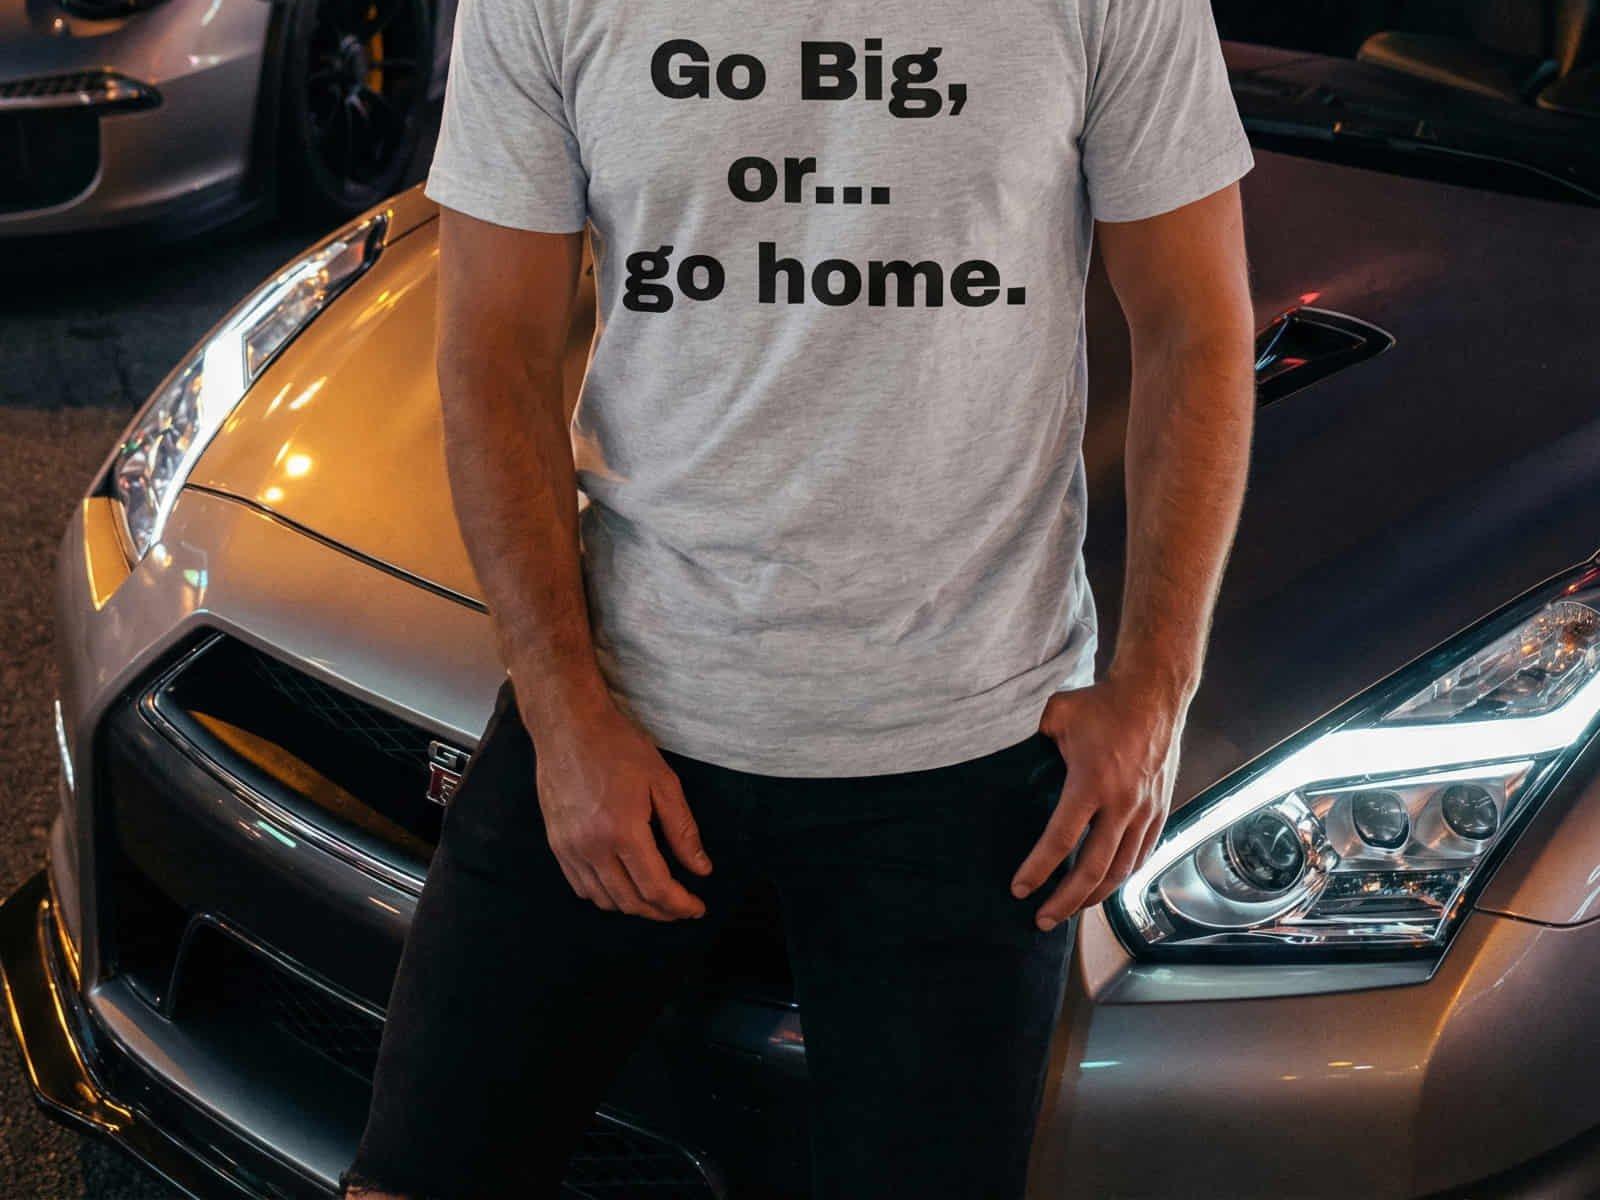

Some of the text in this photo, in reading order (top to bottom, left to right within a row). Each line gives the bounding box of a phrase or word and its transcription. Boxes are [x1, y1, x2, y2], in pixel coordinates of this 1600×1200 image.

[651, 38, 968, 119] Go Big,
[727, 156, 891, 205] or...
[623, 241, 1026, 313] go home.
